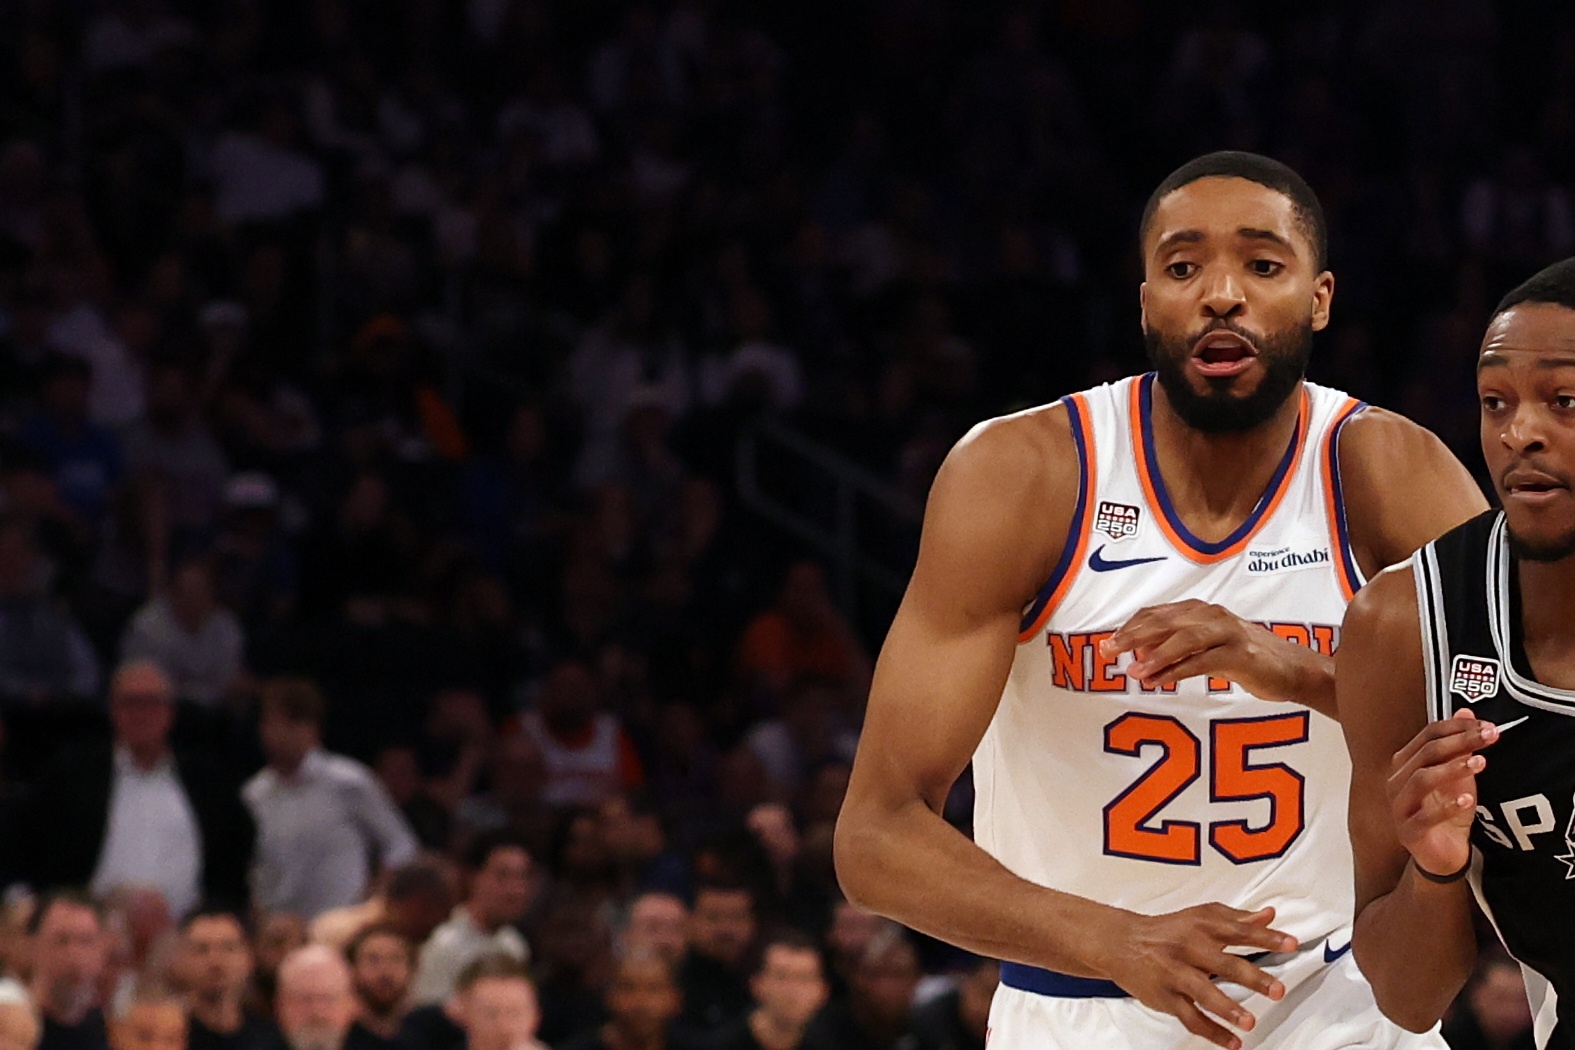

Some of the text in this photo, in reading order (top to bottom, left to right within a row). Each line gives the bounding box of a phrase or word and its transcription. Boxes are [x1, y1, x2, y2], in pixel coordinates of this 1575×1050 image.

[1102, 504, 1136, 518] USA
[1097, 520, 1136, 535] 250
[1248, 548, 1329, 572] abu dhabi
[1459, 661, 1494, 675] USA
[1454, 678, 1494, 693] 250
[1103, 710, 1310, 866] 25
